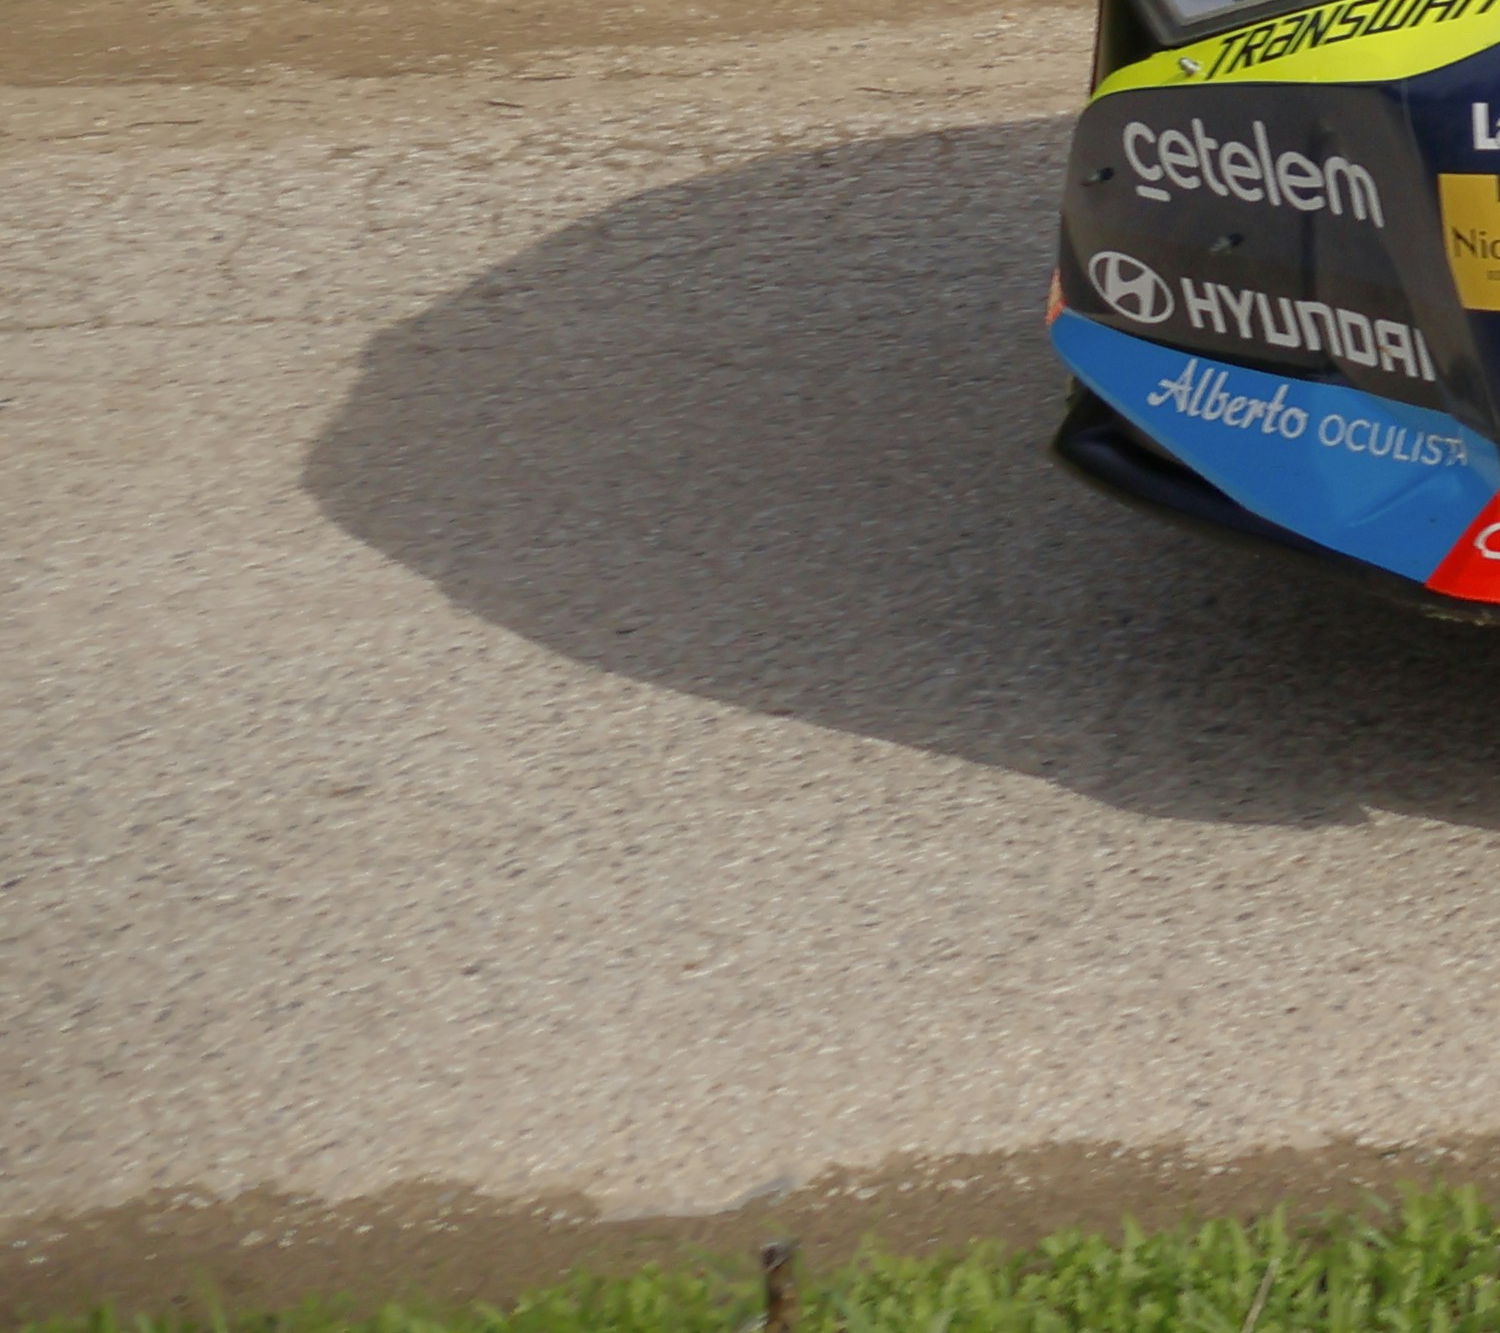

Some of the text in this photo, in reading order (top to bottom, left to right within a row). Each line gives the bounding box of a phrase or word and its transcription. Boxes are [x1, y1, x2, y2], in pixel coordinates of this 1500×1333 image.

[1122, 118, 1385, 229] cetelem
[1181, 278, 1436, 381] HYUNDAI
[1147, 359, 1470, 466] Alberto OCULISTA
